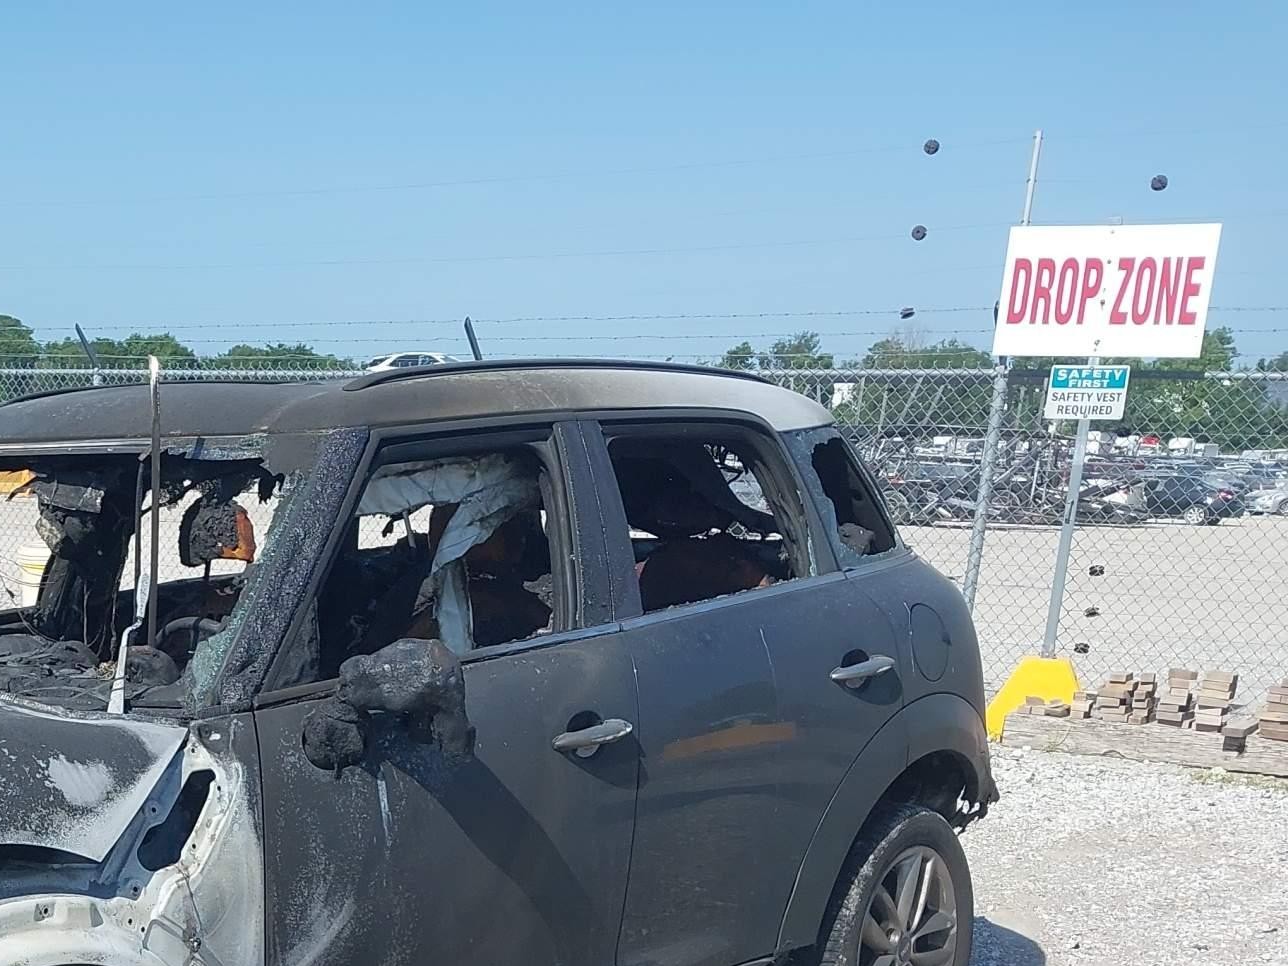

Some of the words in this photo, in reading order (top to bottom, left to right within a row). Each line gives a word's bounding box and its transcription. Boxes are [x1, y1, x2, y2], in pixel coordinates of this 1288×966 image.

[1006, 257, 1104, 325] DROP
[1109, 256, 1206, 325] ZONE
[1057, 369, 1123, 381] SAFETY
[1068, 379, 1110, 388] FIRST
[1051, 391, 1093, 402] SAFETY
[1096, 392, 1122, 403] VEST
[1056, 404, 1113, 416] REQUIRED
